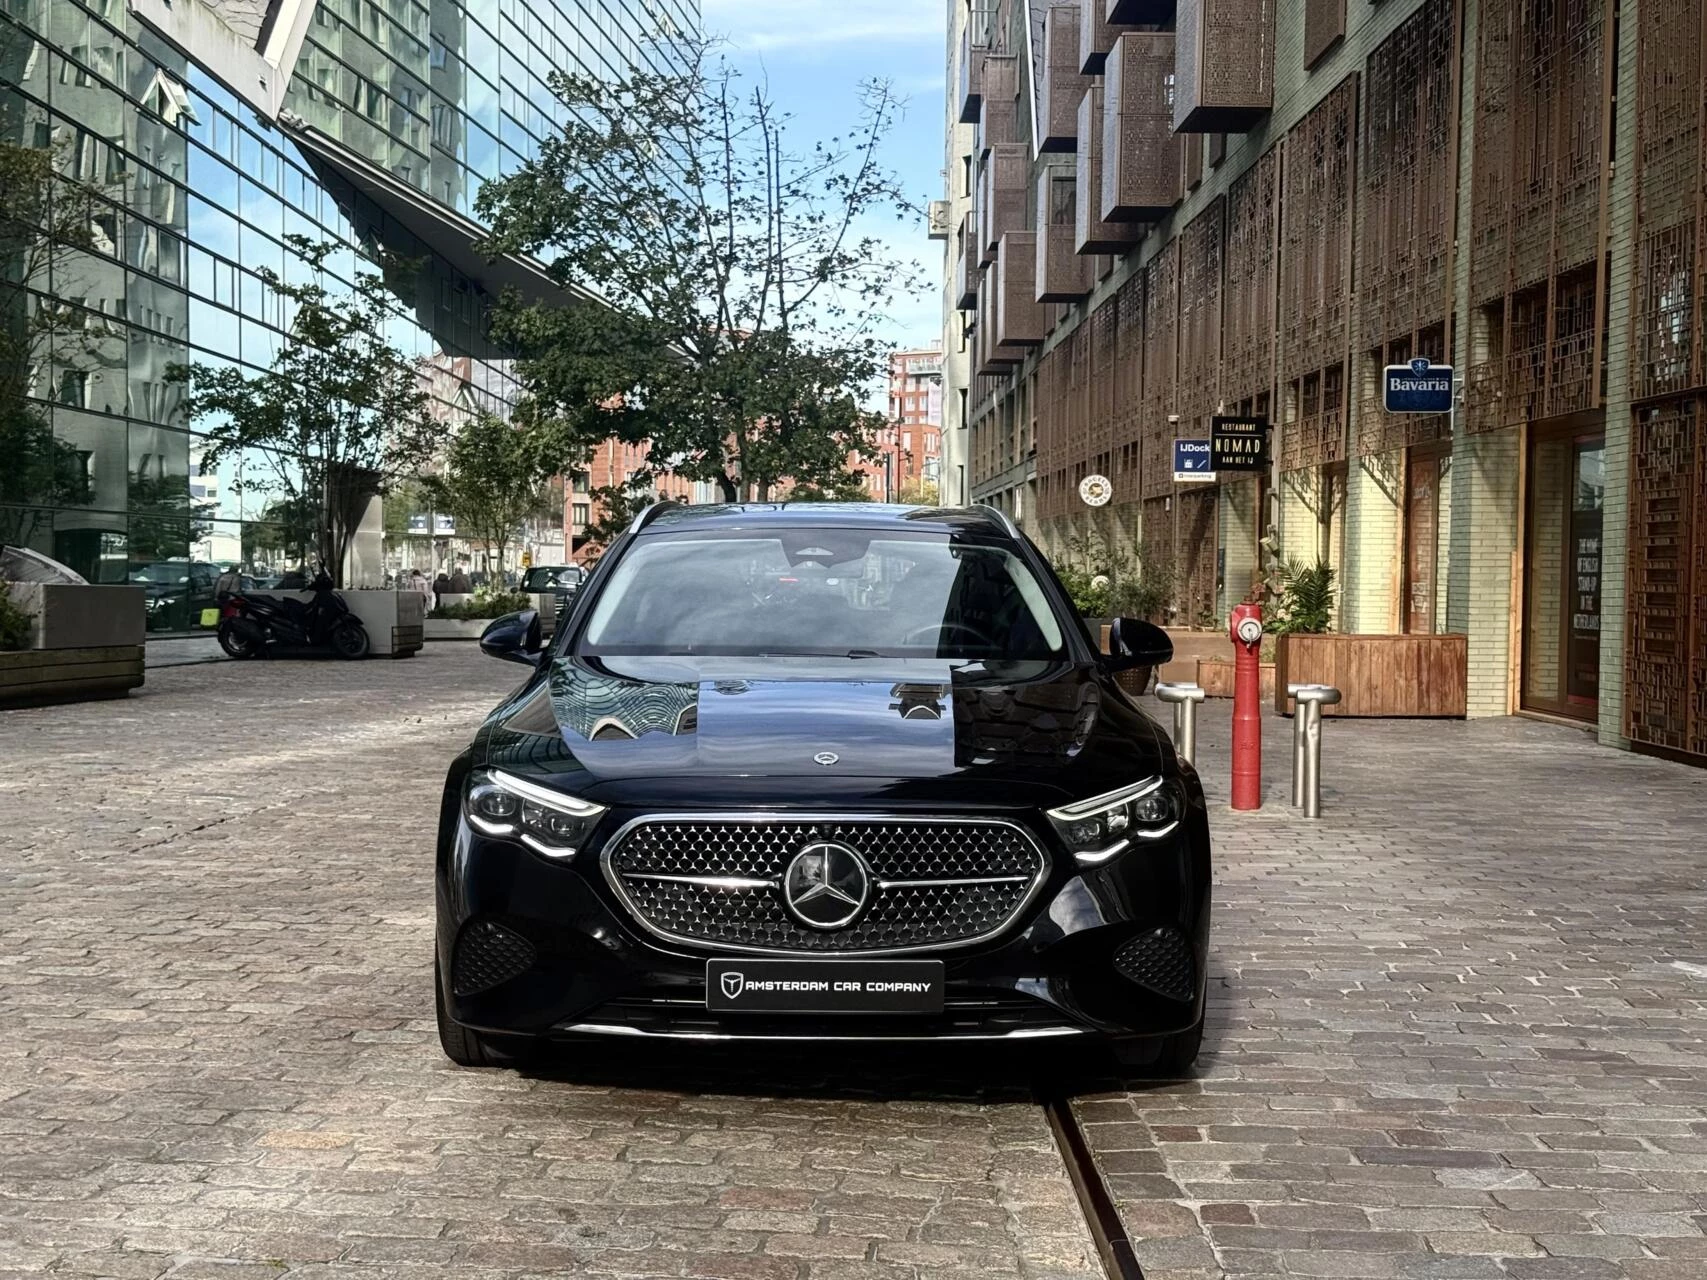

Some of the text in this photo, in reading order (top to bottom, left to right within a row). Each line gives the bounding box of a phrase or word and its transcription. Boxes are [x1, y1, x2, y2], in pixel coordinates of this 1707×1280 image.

[1390, 378, 1449, 391] Bavaria
[1221, 423, 1256, 432] RESTAURANT
[1180, 443, 1210, 453] IJDock
[1215, 438, 1260, 454] NOMAD
[745, 980, 931, 993] AMSTERDAM CAR COMPANY
